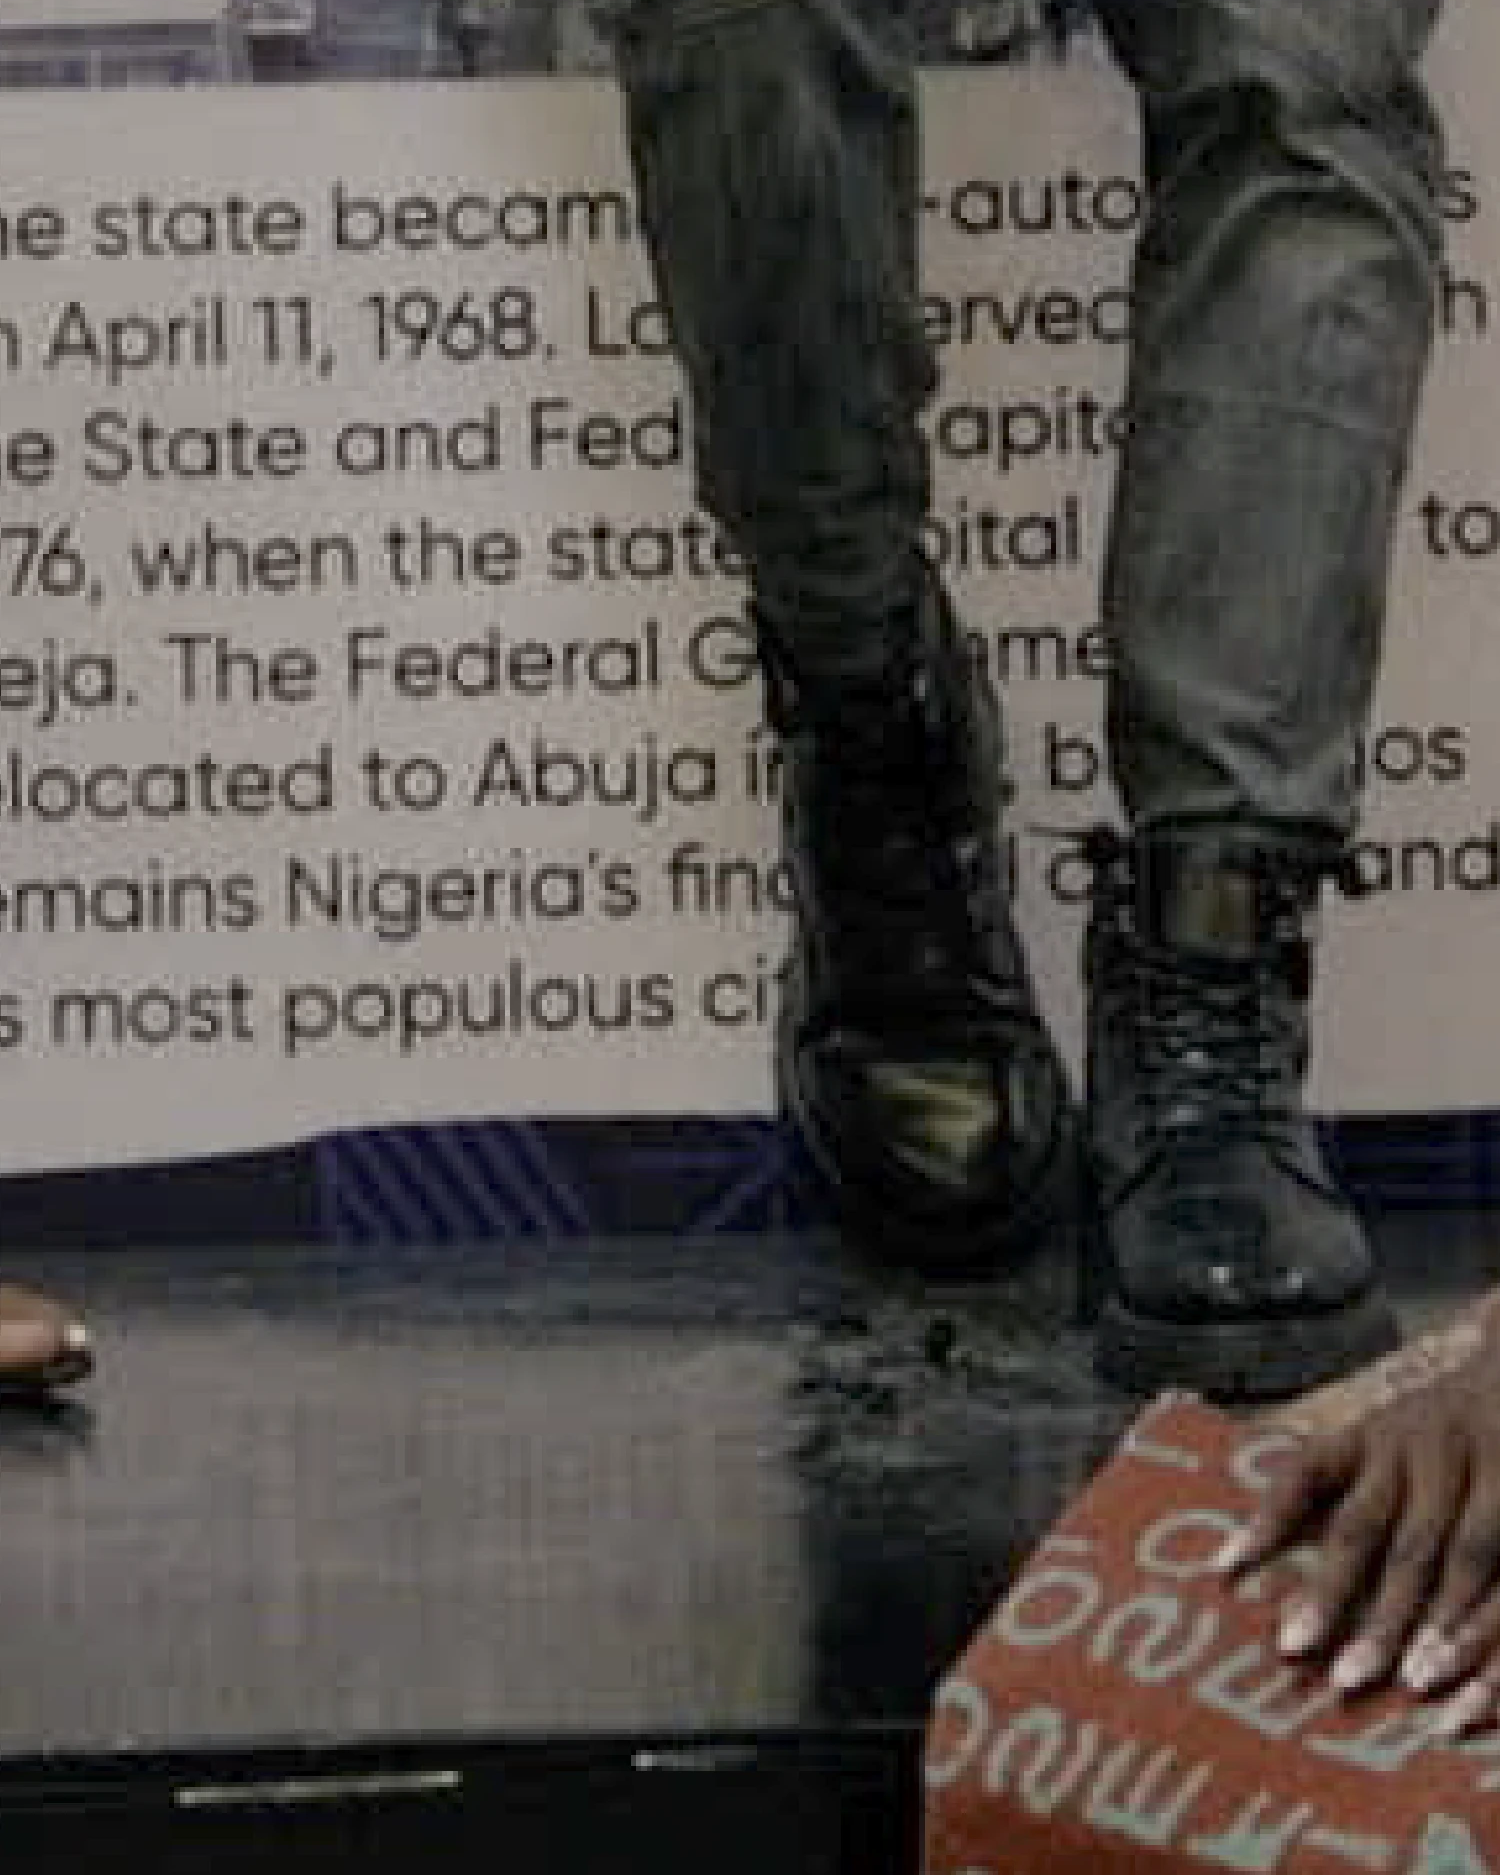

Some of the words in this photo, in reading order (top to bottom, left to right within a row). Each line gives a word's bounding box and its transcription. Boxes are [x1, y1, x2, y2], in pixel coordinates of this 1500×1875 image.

[95, 196, 302, 256] state
[334, 179, 632, 249] becam
[43, 297, 227, 384] April
[253, 294, 336, 377] 11,
[366, 287, 557, 362] 1968.
[83, 411, 307, 482] State
[335, 405, 500, 477] and
[530, 397, 684, 471] Fed
[130, 519, 360, 594] when
[388, 515, 523, 587] the
[167, 633, 318, 703] The
[348, 617, 660, 699] Federal
[364, 749, 445, 811] to
[474, 733, 718, 822] Abuja
[285, 847, 642, 939] Nigeria's
[52, 975, 254, 1045] most
[285, 959, 675, 1057] populous
